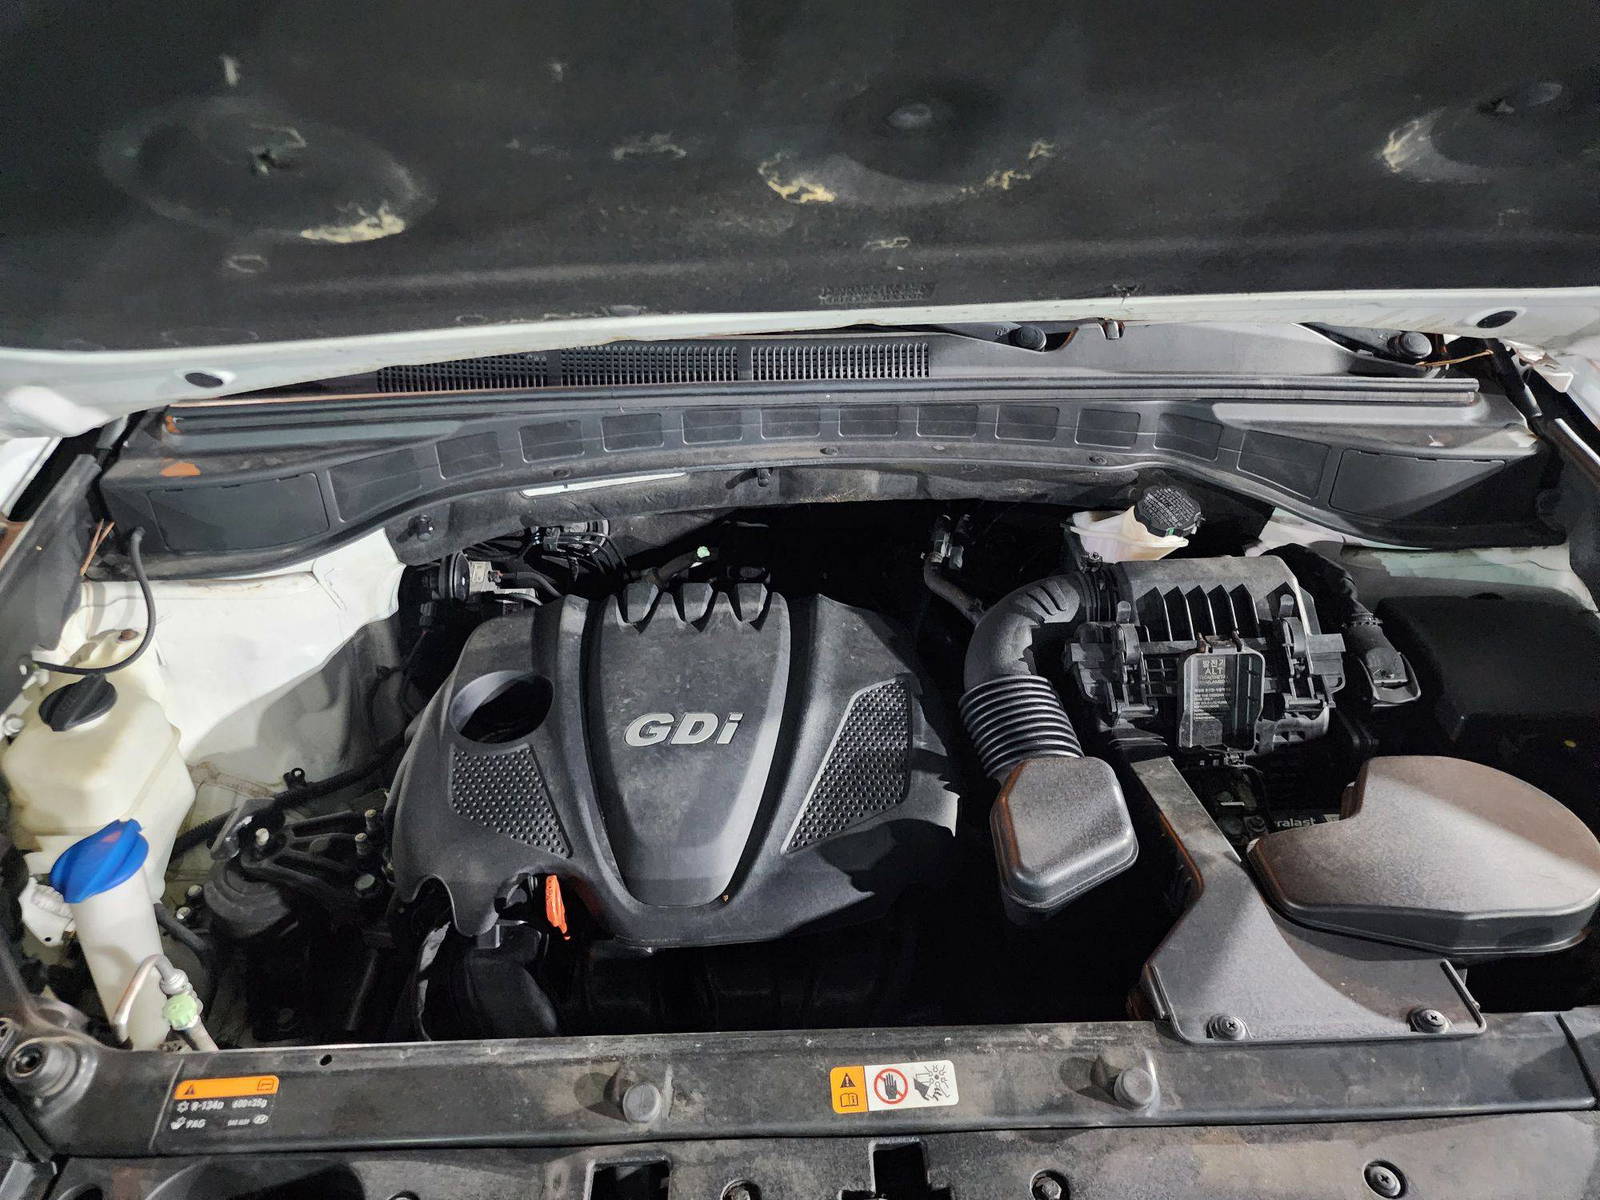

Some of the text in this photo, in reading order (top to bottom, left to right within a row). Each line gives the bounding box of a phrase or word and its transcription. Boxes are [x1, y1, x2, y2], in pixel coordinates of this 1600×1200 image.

[1205, 667, 1223, 675] ALT
[624, 712, 744, 747] GDi
[1276, 817, 1316, 828] ralast
[186, 1119, 206, 1129] PAG
